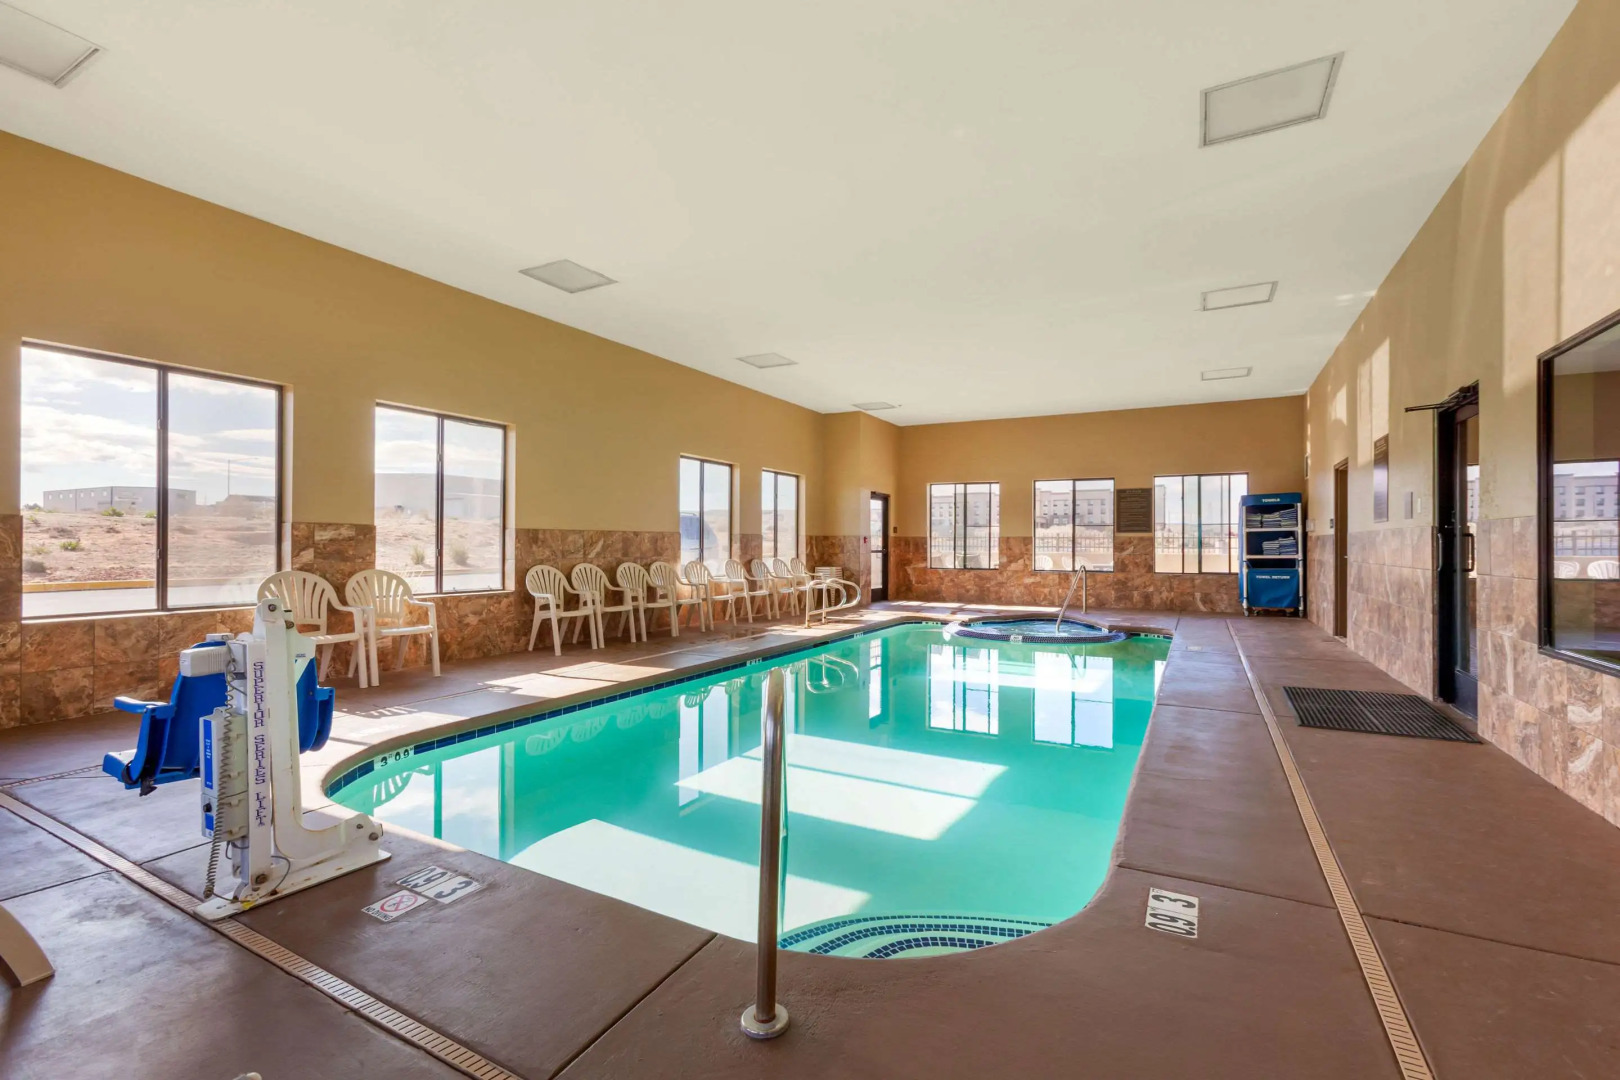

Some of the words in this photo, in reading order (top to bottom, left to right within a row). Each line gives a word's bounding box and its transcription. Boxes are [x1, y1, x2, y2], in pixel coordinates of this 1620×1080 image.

[253, 661, 265, 728] SUPERIOR
[254, 735, 266, 785] SERIES
[380, 756, 388, 767] 3
[255, 791, 267, 827] LIFT
[1151, 894, 1196, 908] 3
[371, 910, 393, 920] DIVING
